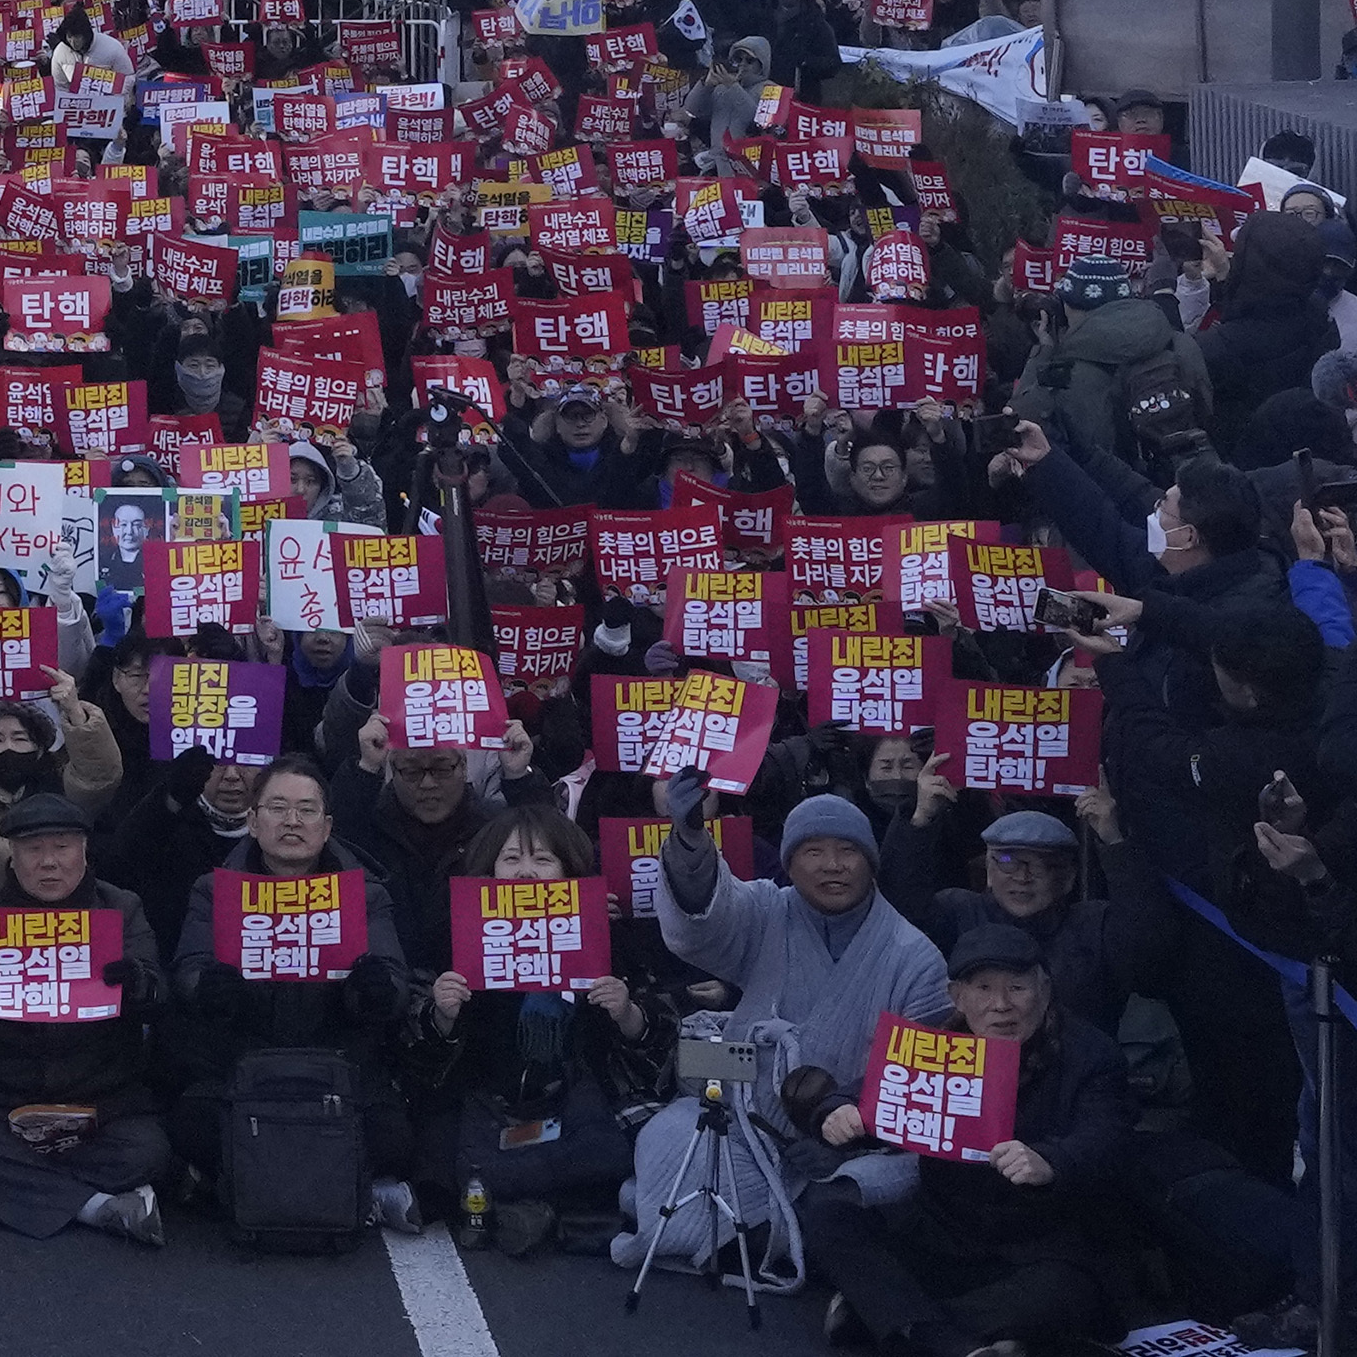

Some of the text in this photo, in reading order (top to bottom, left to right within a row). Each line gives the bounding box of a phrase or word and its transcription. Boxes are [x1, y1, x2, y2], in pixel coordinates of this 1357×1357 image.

[384, 155, 438, 186] 탄핵
[615, 149, 662, 167] 윤석열을
[618, 165, 665, 182] 탄핵하라
[787, 150, 840, 180] 탄핵
[874, 243, 923, 263] 윤석열을
[870, 262, 925, 283] 탄핵하라
[21, 292, 90, 327] 탄핵
[428, 299, 509, 323] 윤석열 체포
[436, 284, 495, 305] 내란수괴
[536, 311, 610, 350] 탄핵
[743, 370, 820, 407] 탄핵
[598, 526, 715, 555] 촛불의 힘으로
[169, 544, 243, 574] 내란죄
[600, 556, 656, 580] 나라를
[170, 573, 243, 605] 윤석열
[171, 602, 230, 636] 탄핵!
[404, 650, 484, 681] 내란죄
[831, 638, 922, 667] 내란죄
[171, 663, 229, 695] 퇴진
[832, 668, 923, 701] 윤석열
[171, 695, 258, 729] 광장을
[404, 679, 487, 713] 윤석열
[967, 689, 1069, 721] 내란죄
[406, 713, 475, 746] 탄핵!
[831, 699, 903, 732] 탄핵!
[965, 722, 1069, 756] 윤석열
[964, 756, 1045, 790] 탄핵!
[242, 874, 341, 912] 내란죄
[481, 880, 579, 917] 내란죄
[241, 908, 341, 946] 윤석열
[482, 916, 582, 954] 윤석열
[241, 947, 320, 979] 탄핵!
[482, 952, 561, 989] 탄핵!
[886, 1024, 986, 1077] 내란죄
[881, 1064, 983, 1117] 윤석열
[875, 1101, 955, 1151] 탄핵!
